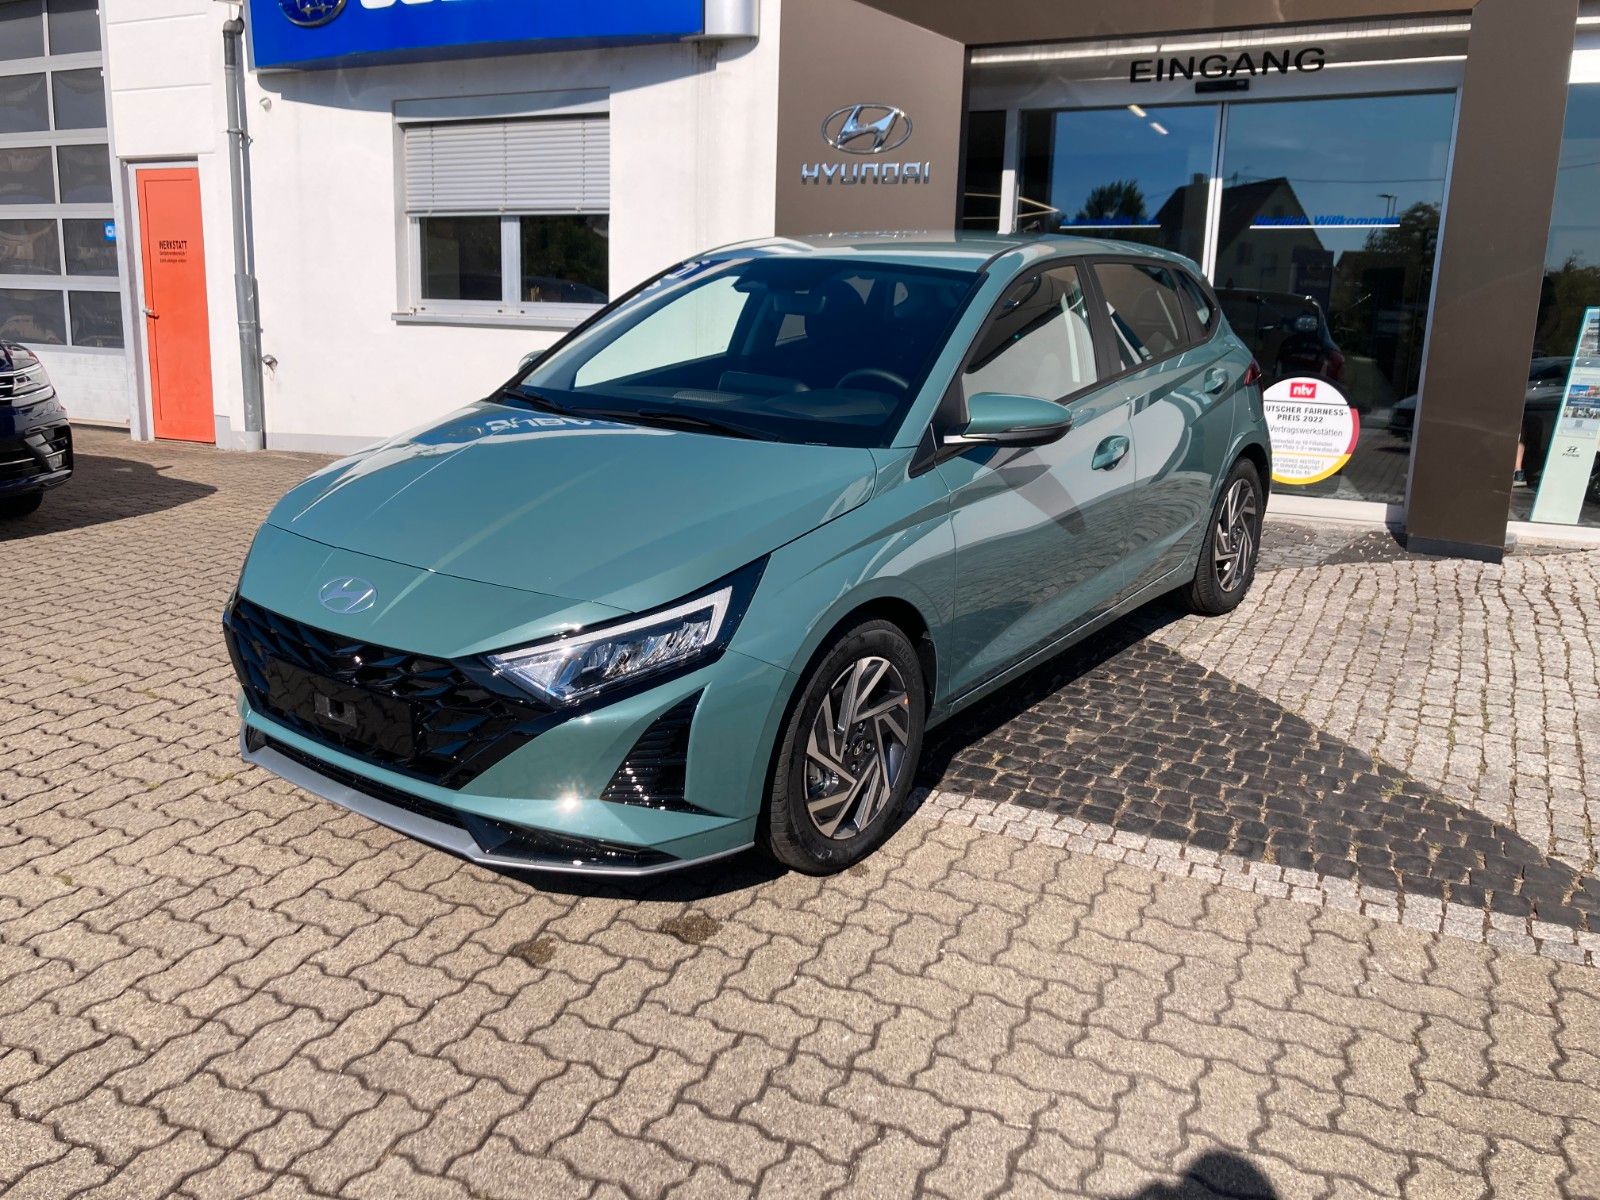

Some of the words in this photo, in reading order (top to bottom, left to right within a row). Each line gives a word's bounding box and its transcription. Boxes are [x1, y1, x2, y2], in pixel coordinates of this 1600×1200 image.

[1129, 47, 1326, 83] EINGANG
[801, 161, 930, 185] HYUNDAI
[1292, 384, 1314, 397] ntv
[1264, 405, 1302, 413] UTSCHER
[1304, 407, 1349, 416] FAIRNESS-
[1277, 414, 1300, 422] PREIS
[1303, 415, 1324, 423] 2022
